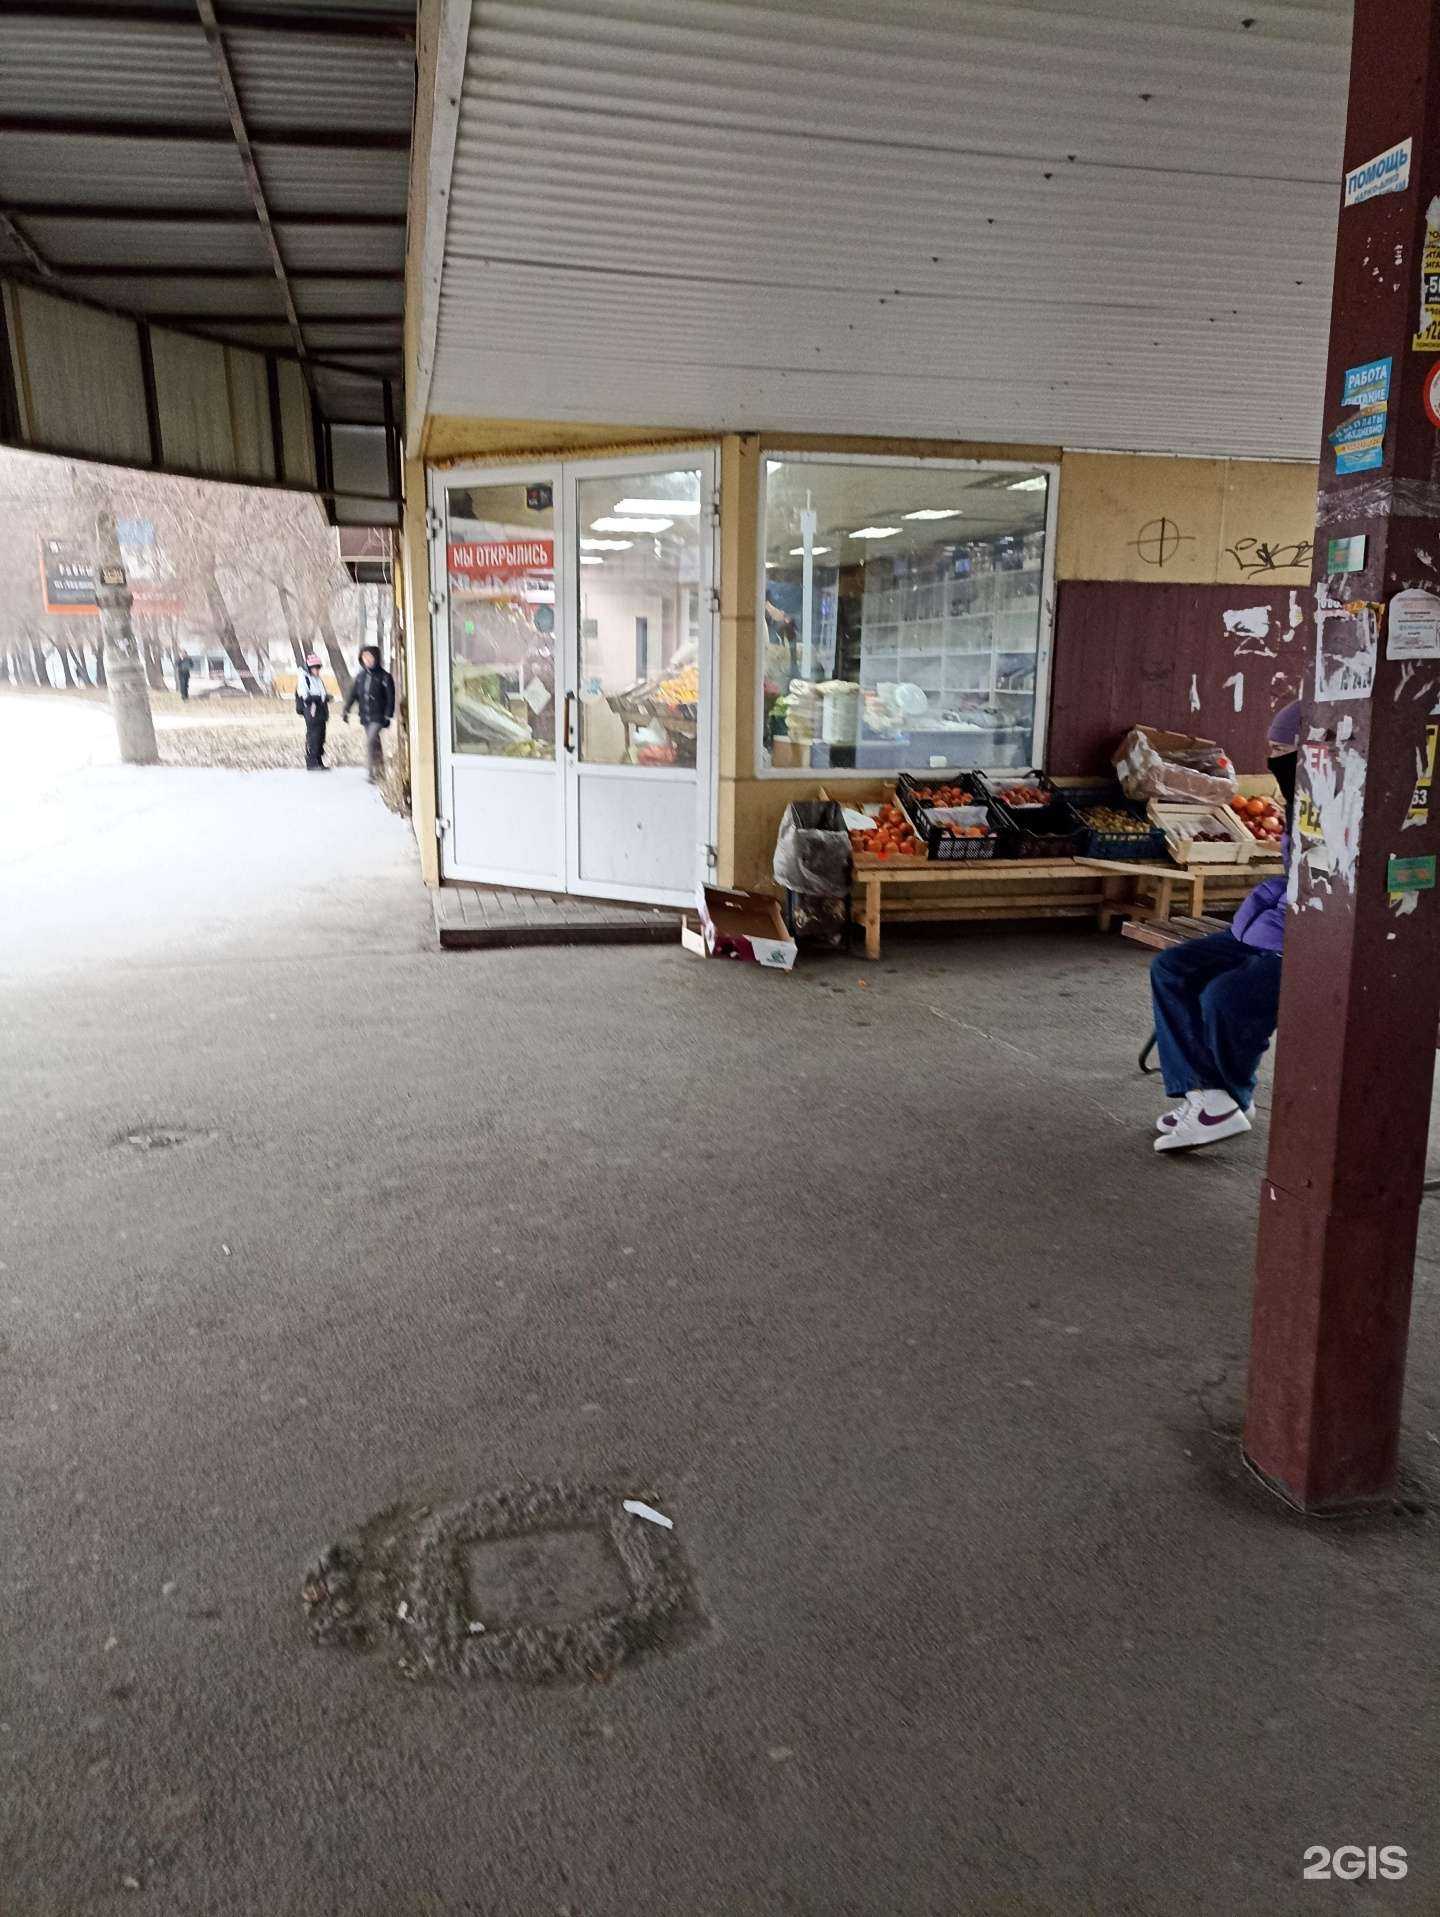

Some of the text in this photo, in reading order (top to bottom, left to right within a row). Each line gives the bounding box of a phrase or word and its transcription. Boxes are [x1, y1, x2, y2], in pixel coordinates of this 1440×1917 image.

[1348, 148, 1408, 195] ПОМОЩЬ
[1348, 365, 1388, 390] РАБОТА
[453, 543, 548, 568] МЫ ОТКРЫЛИСЬ
